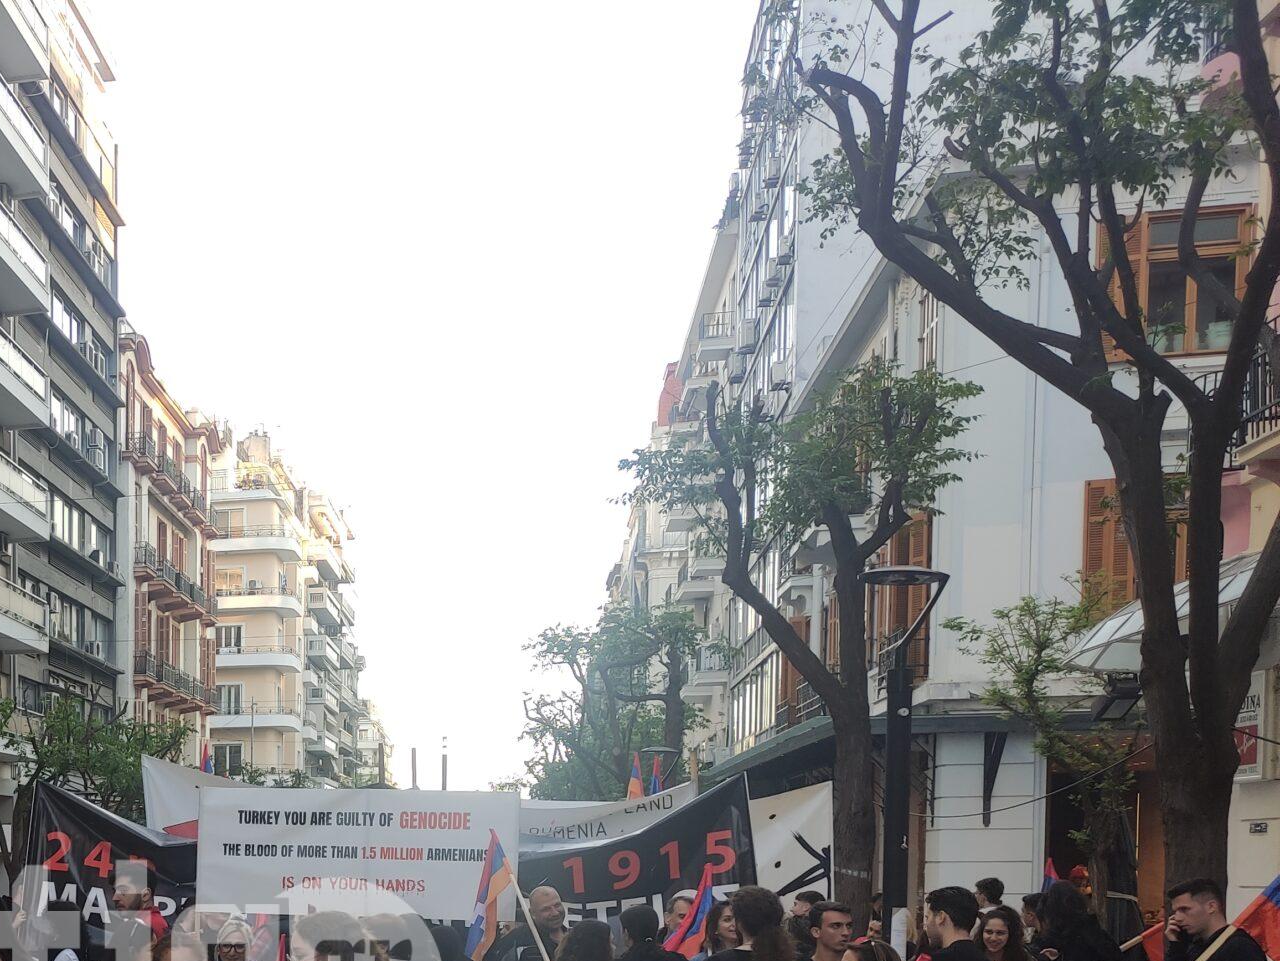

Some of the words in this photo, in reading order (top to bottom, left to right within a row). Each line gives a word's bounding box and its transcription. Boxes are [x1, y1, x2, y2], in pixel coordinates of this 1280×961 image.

[237, 809, 281, 826] TURKEY
[283, 810, 307, 826] YOU
[309, 811, 333, 826] ARE
[335, 811, 376, 827] GUILTY
[379, 811, 394, 827] OF
[399, 811, 471, 830] GENOCIDE
[222, 843, 241, 857] THE
[244, 843, 278, 857] BLOOD
[280, 844, 294, 858] OF
[296, 844, 328, 859] MORE
[331, 845, 358, 859] THAN
[361, 846, 377, 860] 1.5
[379, 846, 424, 861] MILLION
[562, 829, 737, 894] 1915
[281, 875, 295, 889] IS
[301, 876, 322, 889] ON
[328, 877, 368, 891] YOUR
[375, 878, 426, 893] HANDS
